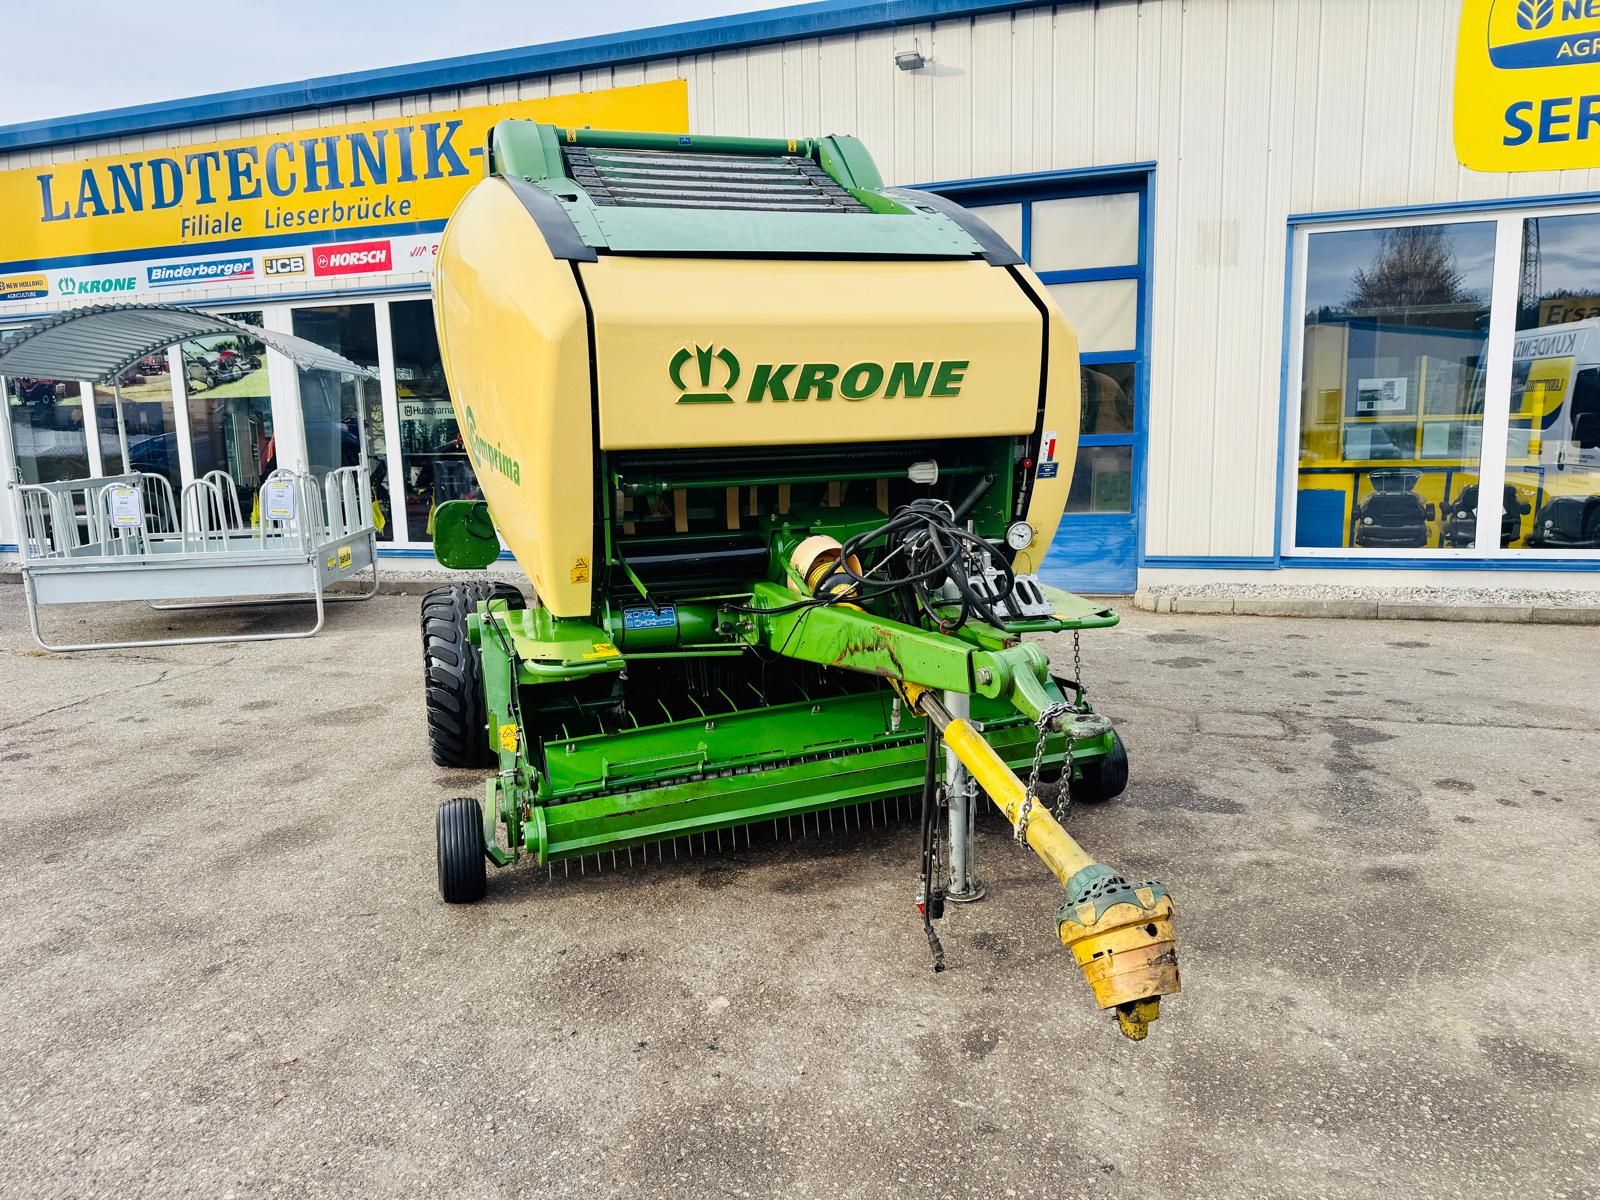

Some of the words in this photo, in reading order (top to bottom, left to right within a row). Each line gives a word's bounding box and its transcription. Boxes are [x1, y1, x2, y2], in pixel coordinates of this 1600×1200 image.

[1502, 93, 1600, 147] SER
[181, 211, 243, 238] Filiale
[264, 194, 412, 230] Lieserbrücke
[266, 257, 304, 274] JCB
[329, 249, 387, 267] HORSCH
[151, 260, 252, 280] Binderberger
[5, 281, 20, 290] NEW
[20, 279, 44, 289] HOLLAND
[78, 276, 137, 294] KRONE
[746, 359, 971, 403] KRONE
[413, 405, 455, 417] Husqvarna
[465, 405, 521, 487] Comprima
